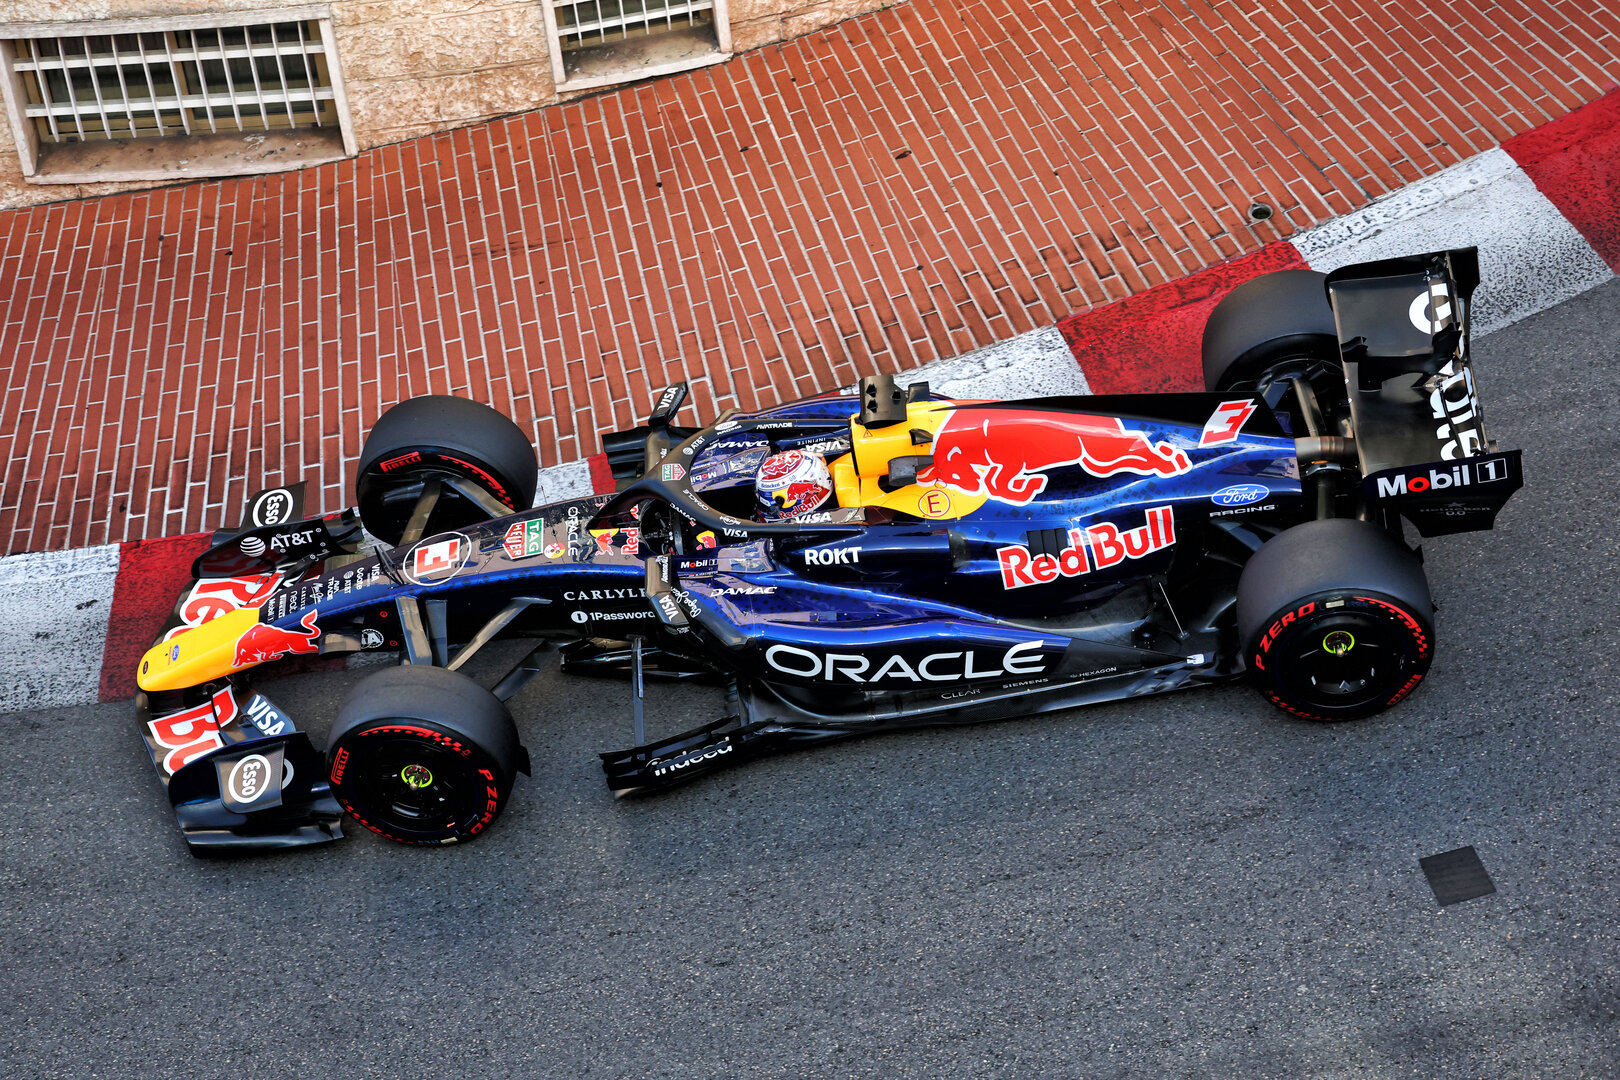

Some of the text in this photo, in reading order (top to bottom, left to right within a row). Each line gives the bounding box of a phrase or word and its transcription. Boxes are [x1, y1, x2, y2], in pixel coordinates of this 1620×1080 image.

[658, 386, 678, 410] VISA
[691, 436, 706, 450] AT&T
[797, 437, 826, 446] INFINITE
[805, 440, 842, 453] VISA
[380, 451, 422, 473] PIRELLI
[690, 471, 717, 485] Mobil
[1377, 462, 1497, 498] Mobil 1
[798, 495, 820, 512] Bull
[927, 494, 942, 514] E
[1223, 487, 1258, 504] Ford
[794, 511, 832, 523] VISA
[1209, 504, 1276, 518] RACING
[270, 530, 314, 550] AT&T
[505, 523, 523, 557] HEUER
[528, 520, 541, 553] TAG
[567, 506, 579, 557] ORACLE
[620, 527, 639, 555] Red
[722, 528, 748, 538] VISA
[805, 547, 862, 565] ROKT
[996, 505, 1177, 590] Red Bull
[371, 563, 380, 581] VISA
[680, 560, 708, 569] Mobil
[710, 586, 778, 598] DAMAC
[659, 595, 679, 622] VISA
[1255, 601, 1315, 670] P ZERO
[765, 639, 1046, 682] ORACLE
[1079, 667, 1117, 678] HEXAGON
[1002, 678, 1049, 689] SIEMENS
[1387, 673, 1423, 705] PIRELLI
[246, 695, 285, 736] VISA
[147, 685, 239, 777] Bu
[331, 747, 350, 785] PIRELLI
[650, 736, 733, 776] indeed
[471, 769, 498, 834] P ZERO
